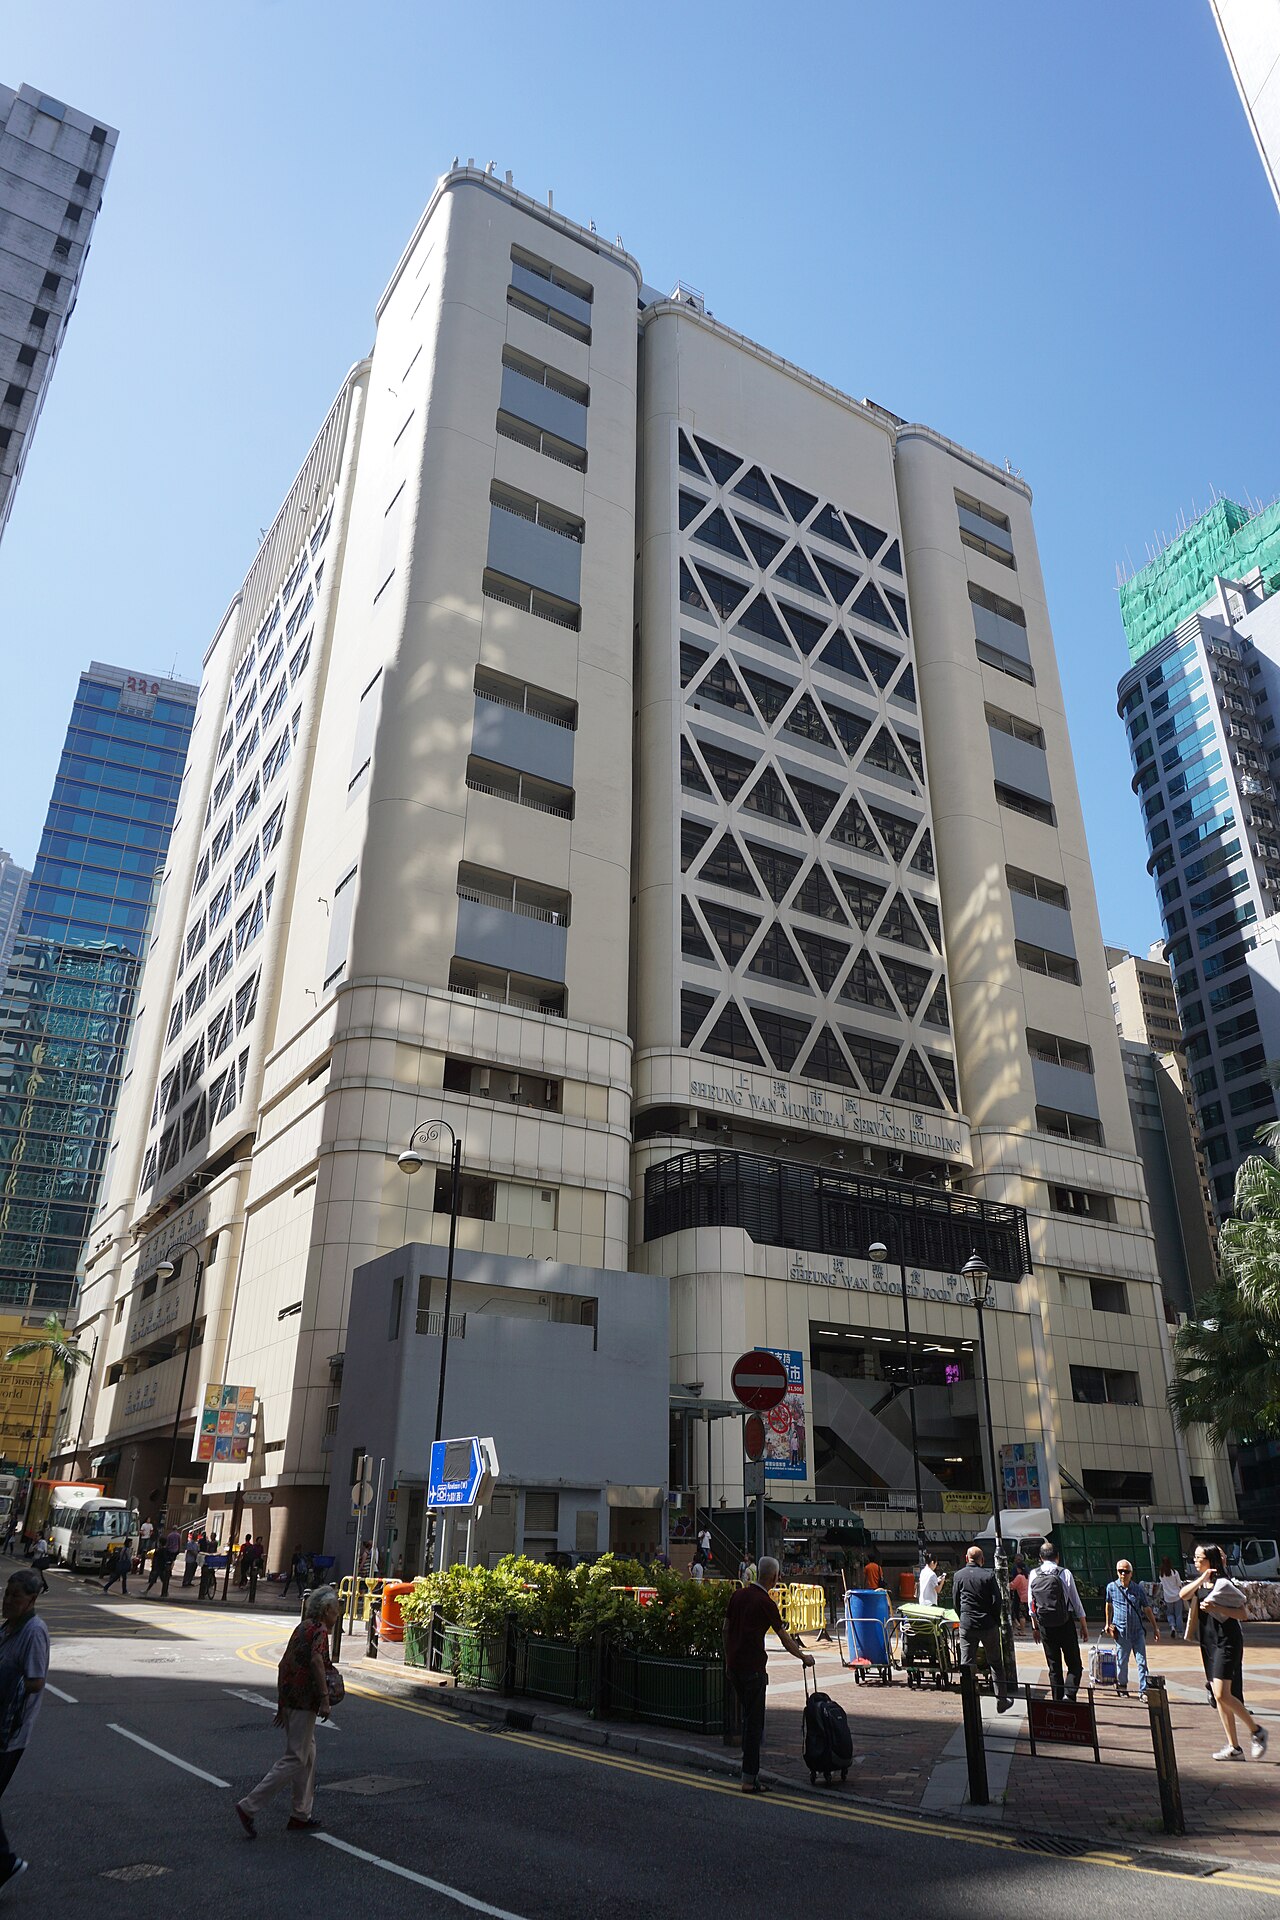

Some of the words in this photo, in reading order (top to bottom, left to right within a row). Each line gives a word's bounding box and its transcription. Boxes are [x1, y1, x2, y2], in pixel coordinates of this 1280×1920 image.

[690, 1081, 743, 1105] SHEUNG
[748, 1093, 777, 1113] WAN
[782, 1102, 849, 1129] MUNICIPAL
[853, 1118, 906, 1141] SERVICES
[910, 1129, 961, 1153] BUILDING
[735, 1072, 924, 1130] 上環市政大廈
[790, 1268, 837, 1286] SHEUNG
[841, 1275, 868, 1290] WAN
[923, 1287, 951, 1301] FOOD
[792, 1251, 992, 1294] 上環熟食中
[0, 1388, 23, 1399] orld
